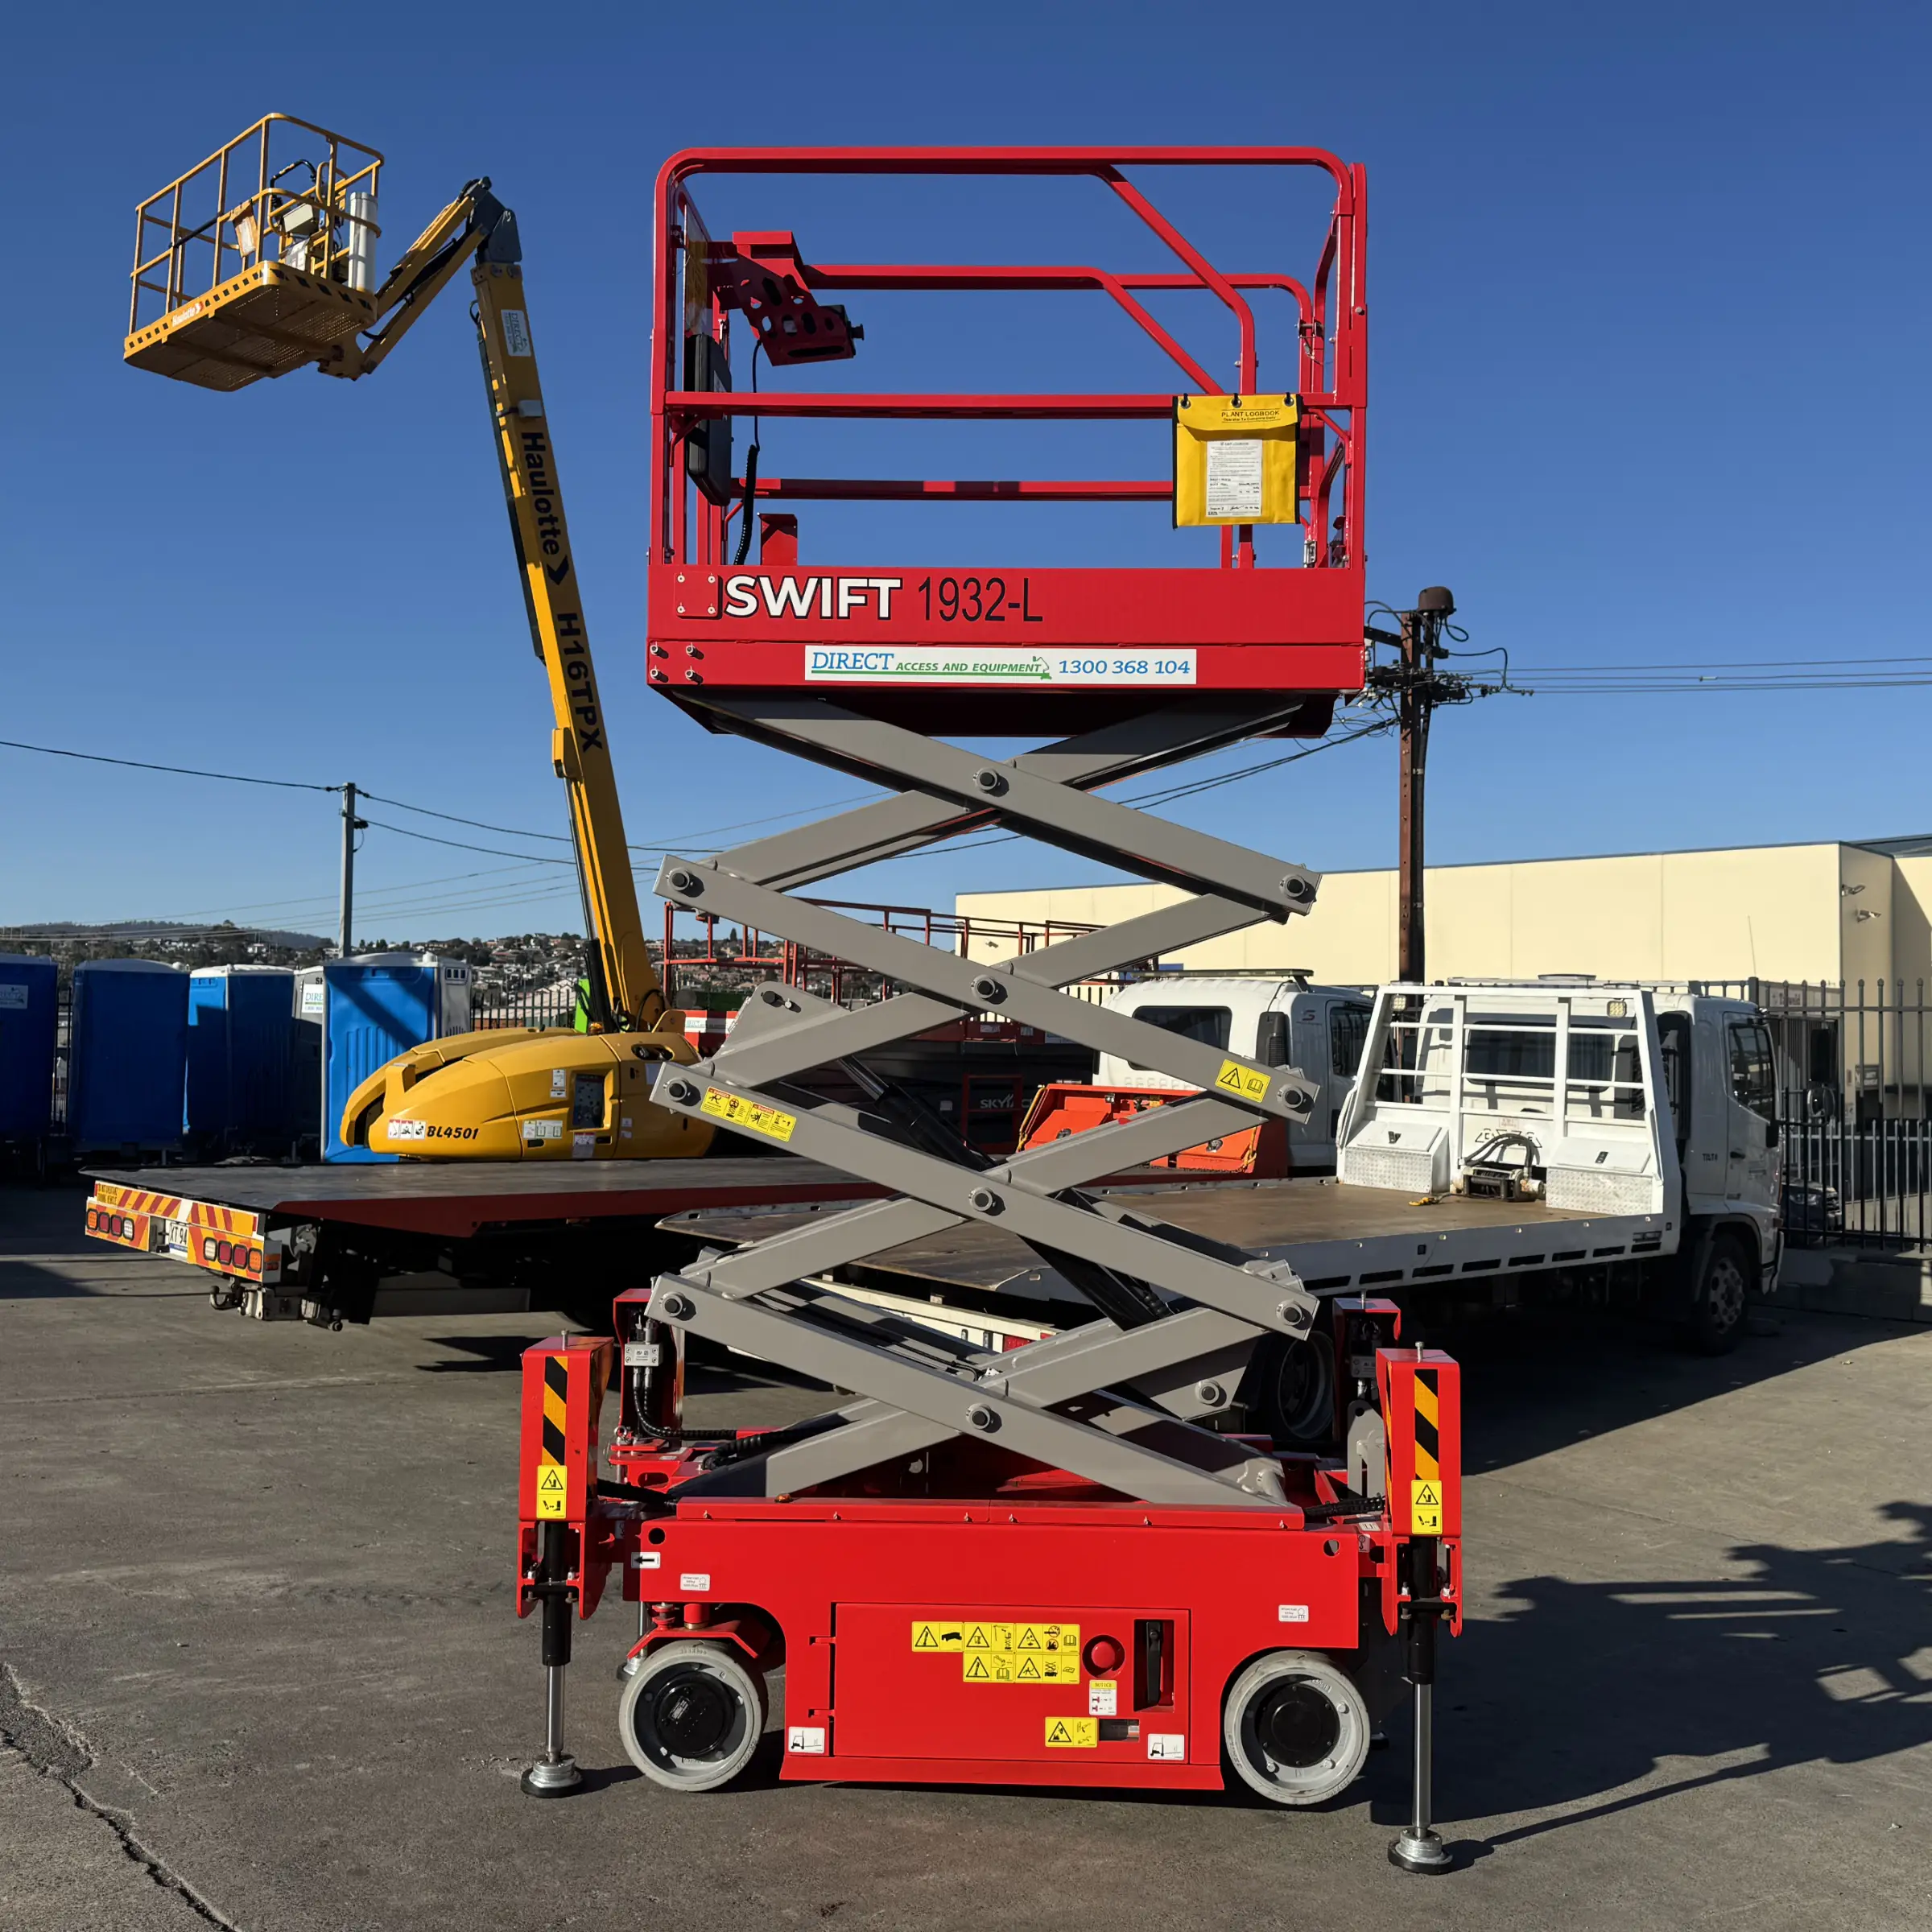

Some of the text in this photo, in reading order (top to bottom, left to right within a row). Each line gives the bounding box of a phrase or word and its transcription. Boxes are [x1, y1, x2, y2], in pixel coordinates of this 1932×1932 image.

[522, 432, 561, 555] Haulotte
[724, 575, 1043, 622] SWIFT 1932-L
[557, 613, 603, 753] H16TPX
[811, 652, 1191, 675] DIRECT ACCESS AND EQUIPMENT 1300 368 104
[427, 1125, 479, 1140] BL4501
